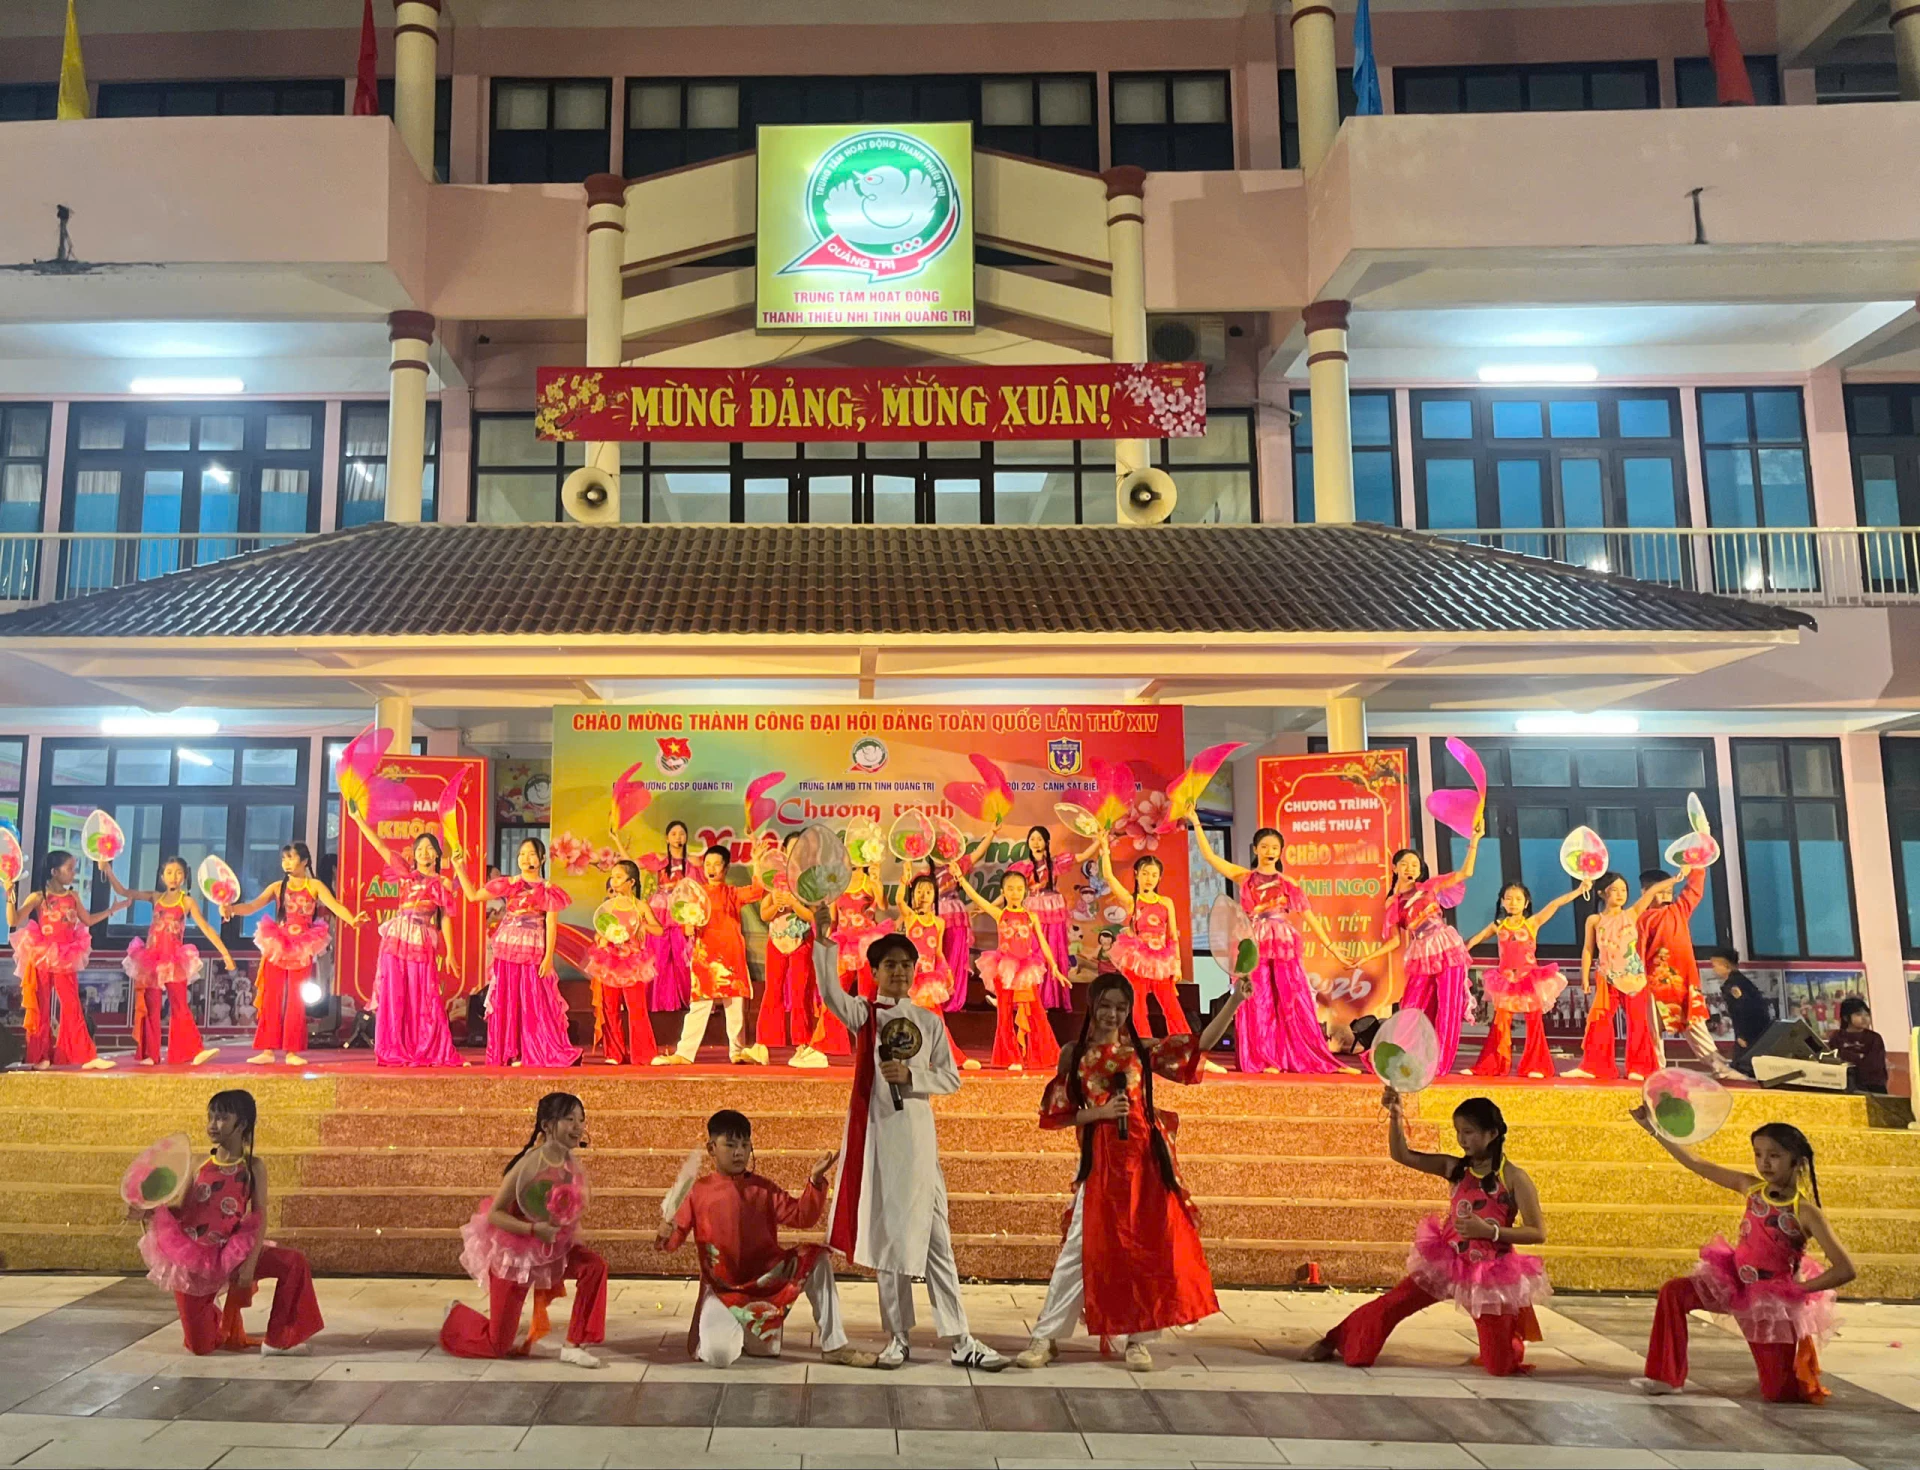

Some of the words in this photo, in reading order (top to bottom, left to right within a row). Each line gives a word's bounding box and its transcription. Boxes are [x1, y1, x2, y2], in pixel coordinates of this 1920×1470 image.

[816, 169, 831, 196] TRUNG
[827, 153, 846, 171] TÂM
[898, 141, 926, 162] THANH
[935, 181, 946, 197] NHI
[793, 291, 834, 304] TRUNG
[839, 290, 865, 303] TÂM
[762, 311, 804, 324] THANH
[847, 311, 868, 323] NHI
[952, 310, 971, 325] TRỊ
[630, 379, 735, 427] MỪNG
[749, 377, 867, 432] ĐẢNG,
[881, 378, 988, 427] MỪNG
[1000, 376, 1110, 425] XUÂN!
[573, 711, 622, 731] CHÀO
[627, 711, 684, 731] MỪNG
[689, 710, 748, 731] THÀNH
[755, 710, 804, 731] CÔNG
[810, 714, 841, 735] ĐẠI
[847, 711, 877, 735] HỘI
[883, 709, 932, 731] ĐẢNG
[938, 708, 986, 731] TOÀN
[992, 708, 1042, 733] QUỐC
[1046, 707, 1083, 732] LẦN
[1087, 709, 1125, 732] THỨ
[1127, 713, 1158, 732] XIV
[669, 781, 689, 791] CĐSP
[799, 782, 824, 791] TRUNG
[845, 782, 856, 791] HĐ
[858, 782, 872, 791] TTN
[1021, 782, 1035, 791] 202
[777, 797, 881, 825] Chương
[1339, 797, 1380, 811] TRÌNH
[1292, 818, 1327, 833] NGHỆ
[1328, 816, 1371, 832] THUẬT
[1298, 874, 1332, 896] ÍNH
[1336, 878, 1380, 899] NGỌ
[1338, 909, 1372, 932] TẾT
